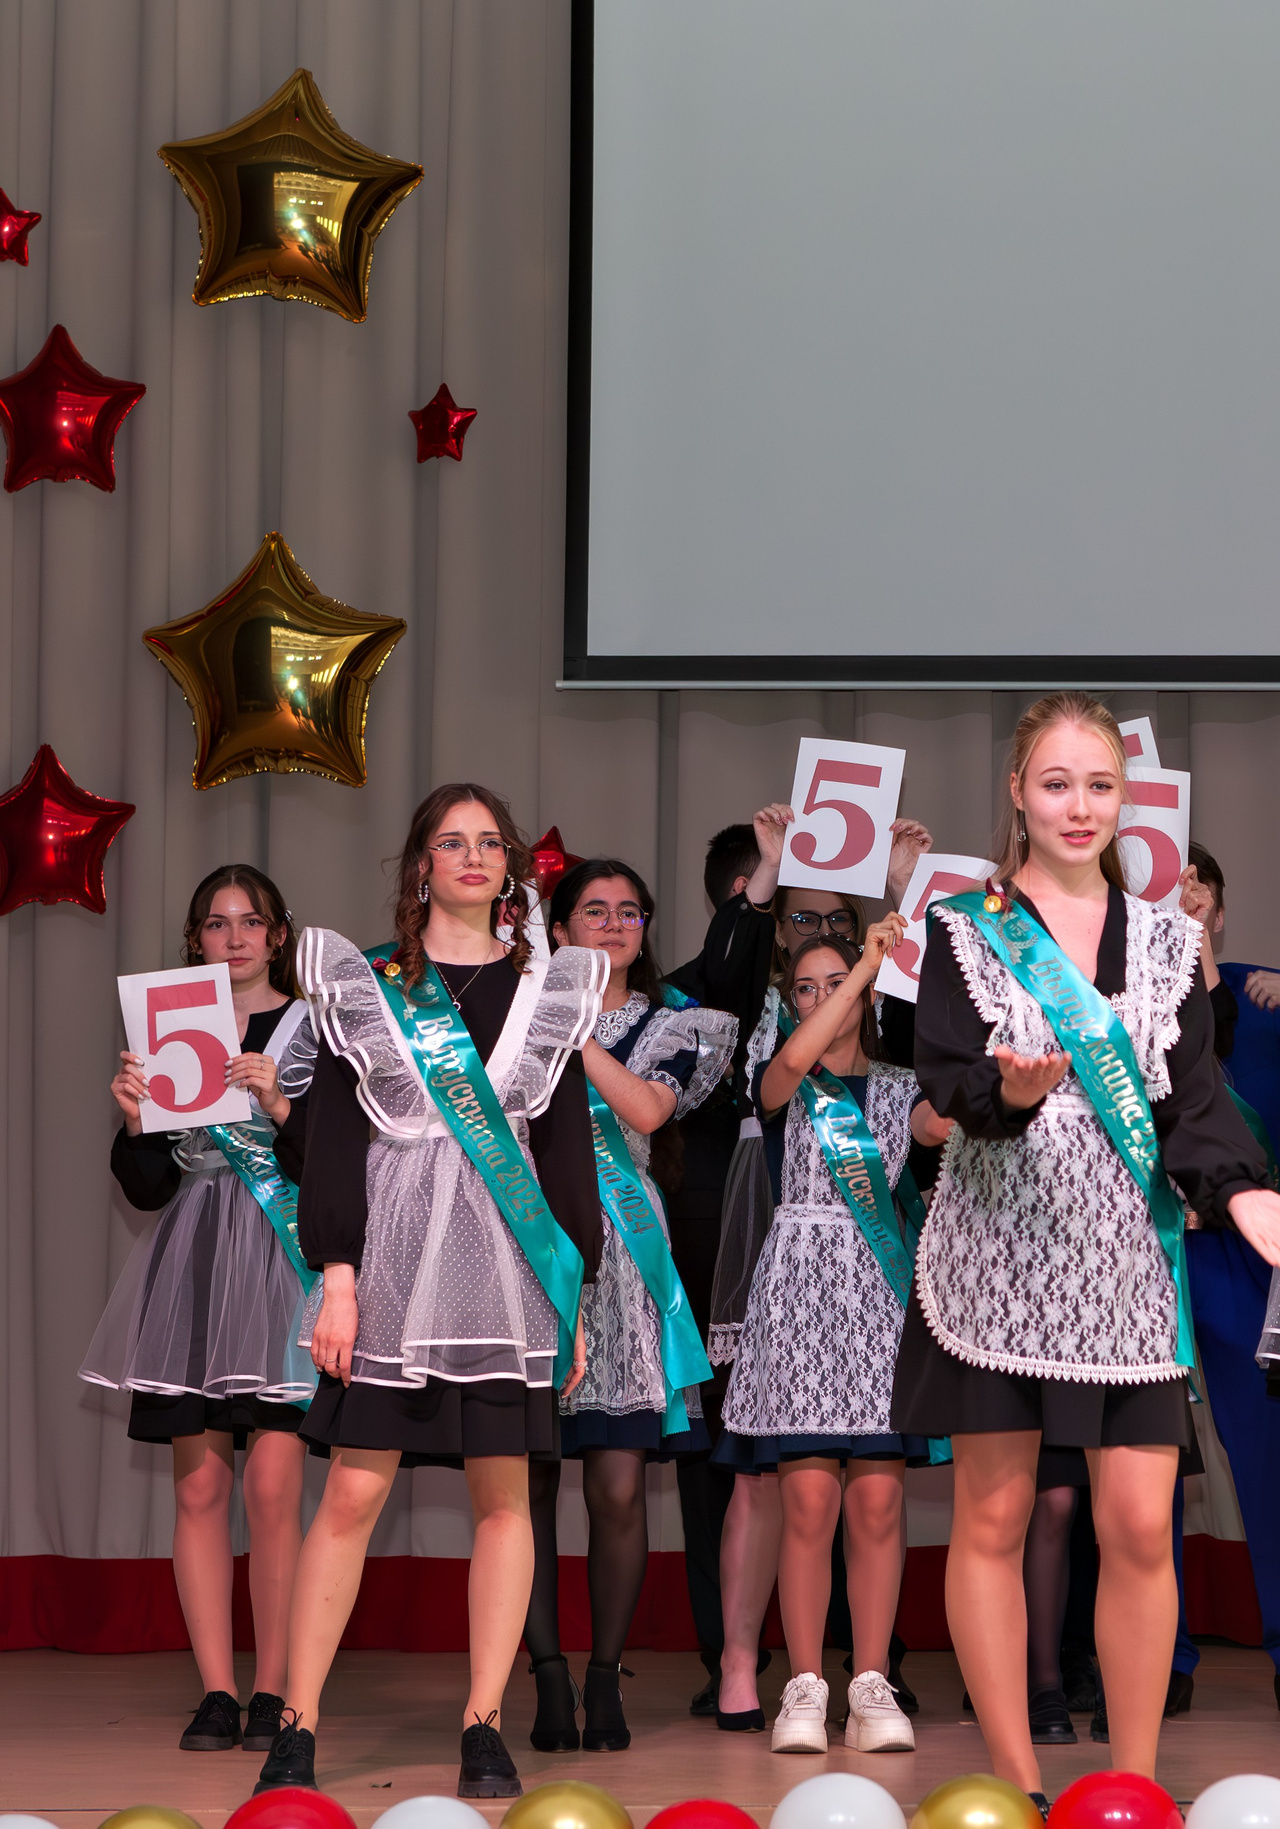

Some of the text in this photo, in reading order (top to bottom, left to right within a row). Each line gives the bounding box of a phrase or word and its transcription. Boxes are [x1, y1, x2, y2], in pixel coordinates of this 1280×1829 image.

[790, 759, 882, 870] 5
[147, 980, 231, 1114] 5
[415, 1013, 546, 1223] Выпускница 2024
[1027, 955, 1143, 1128] Выпускница
[612, 1184, 655, 1235] 2024
[826, 1113, 912, 1293] Выпускница 202
